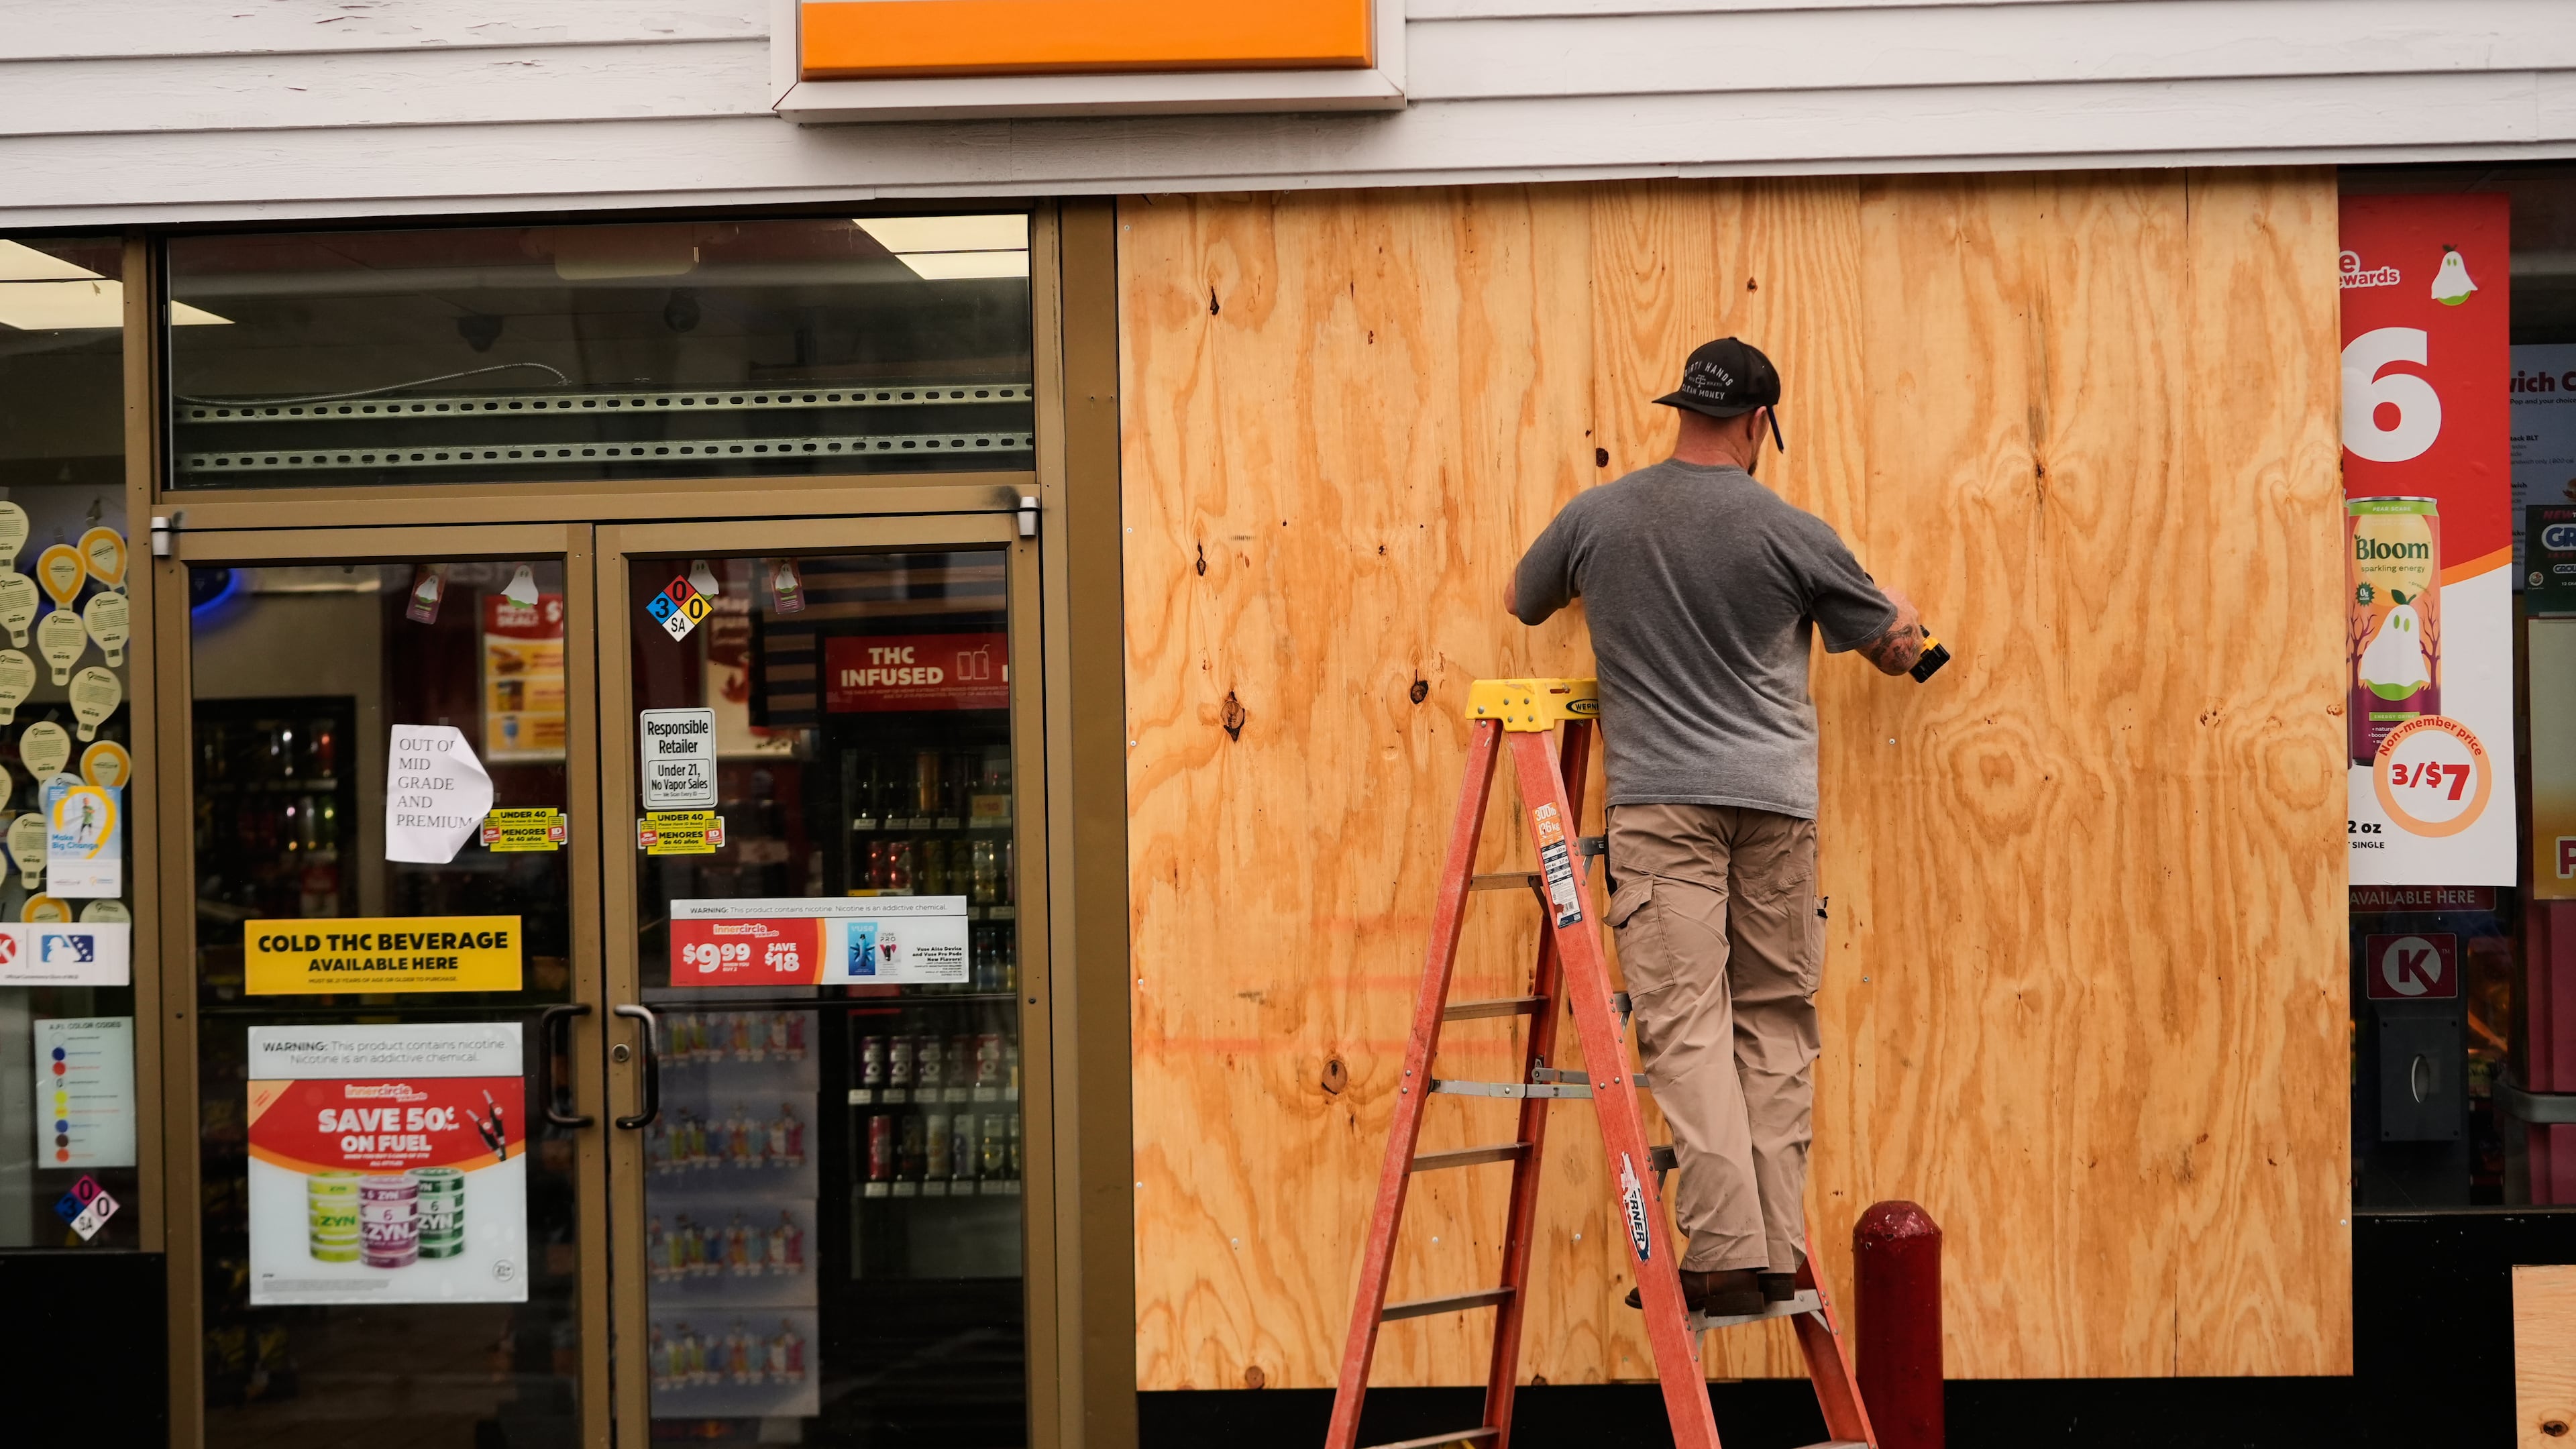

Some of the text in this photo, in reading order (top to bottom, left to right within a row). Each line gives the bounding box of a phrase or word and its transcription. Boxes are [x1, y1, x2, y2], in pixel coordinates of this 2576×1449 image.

[1705, 362, 1733, 386] HANDS
[1699, 389, 1725, 400] MONEY
[2341, 327, 2442, 462] 6
[2543, 510, 2573, 519] NEW
[2355, 536, 2429, 560] Bloom
[2361, 565, 2397, 574] sparkling
[672, 581, 686, 601] 0
[2360, 588, 2369, 597] 0g
[655, 598, 703, 619] 3 0
[671, 617, 686, 633] SA
[868, 646, 914, 665] THC
[841, 667, 944, 688] INFUSED
[647, 719, 708, 737] Responsible
[2379, 716, 2482, 756] Non-member price
[399, 738, 434, 751] OUT
[659, 739, 698, 754] Retailer
[398, 757, 431, 770] MID
[658, 763, 700, 777] Under 21,
[398, 776, 455, 790] GRADE
[651, 778, 708, 792] No Vapor Sales
[2392, 761, 2470, 800] 3/$7
[397, 796, 433, 808] AND
[396, 814, 472, 828] PREMIUM
[1552, 822, 1560, 832] kg
[551, 827, 562, 835] ID
[708, 830, 720, 838] ID
[2361, 823, 2381, 834] oz
[52, 841, 99, 851] Big Change
[2350, 890, 2475, 906] AVAILABLE HERE
[745, 906, 773, 914] product
[714, 924, 766, 934] innercircle
[258, 931, 508, 953] COLD THC BEVERAGE
[767, 943, 797, 951] SAVE
[308, 957, 458, 971] AVAILABLE HERE
[765, 952, 800, 972] $18
[262, 1040, 508, 1053] WARNING: This product contains nicotine.
[290, 1051, 480, 1064] Nicotine is an addictive chemical.
[318, 1108, 401, 1133] SAVE
[341, 1134, 433, 1153] ON FUEL
[79, 1179, 93, 1201] 0
[62, 1197, 110, 1217] 3 0
[431, 1200, 439, 1212] 6
[320, 1215, 356, 1227] ZYN
[384, 1209, 392, 1222] 6
[419, 1214, 453, 1230] ZYN
[368, 1224, 409, 1241] ZYN
